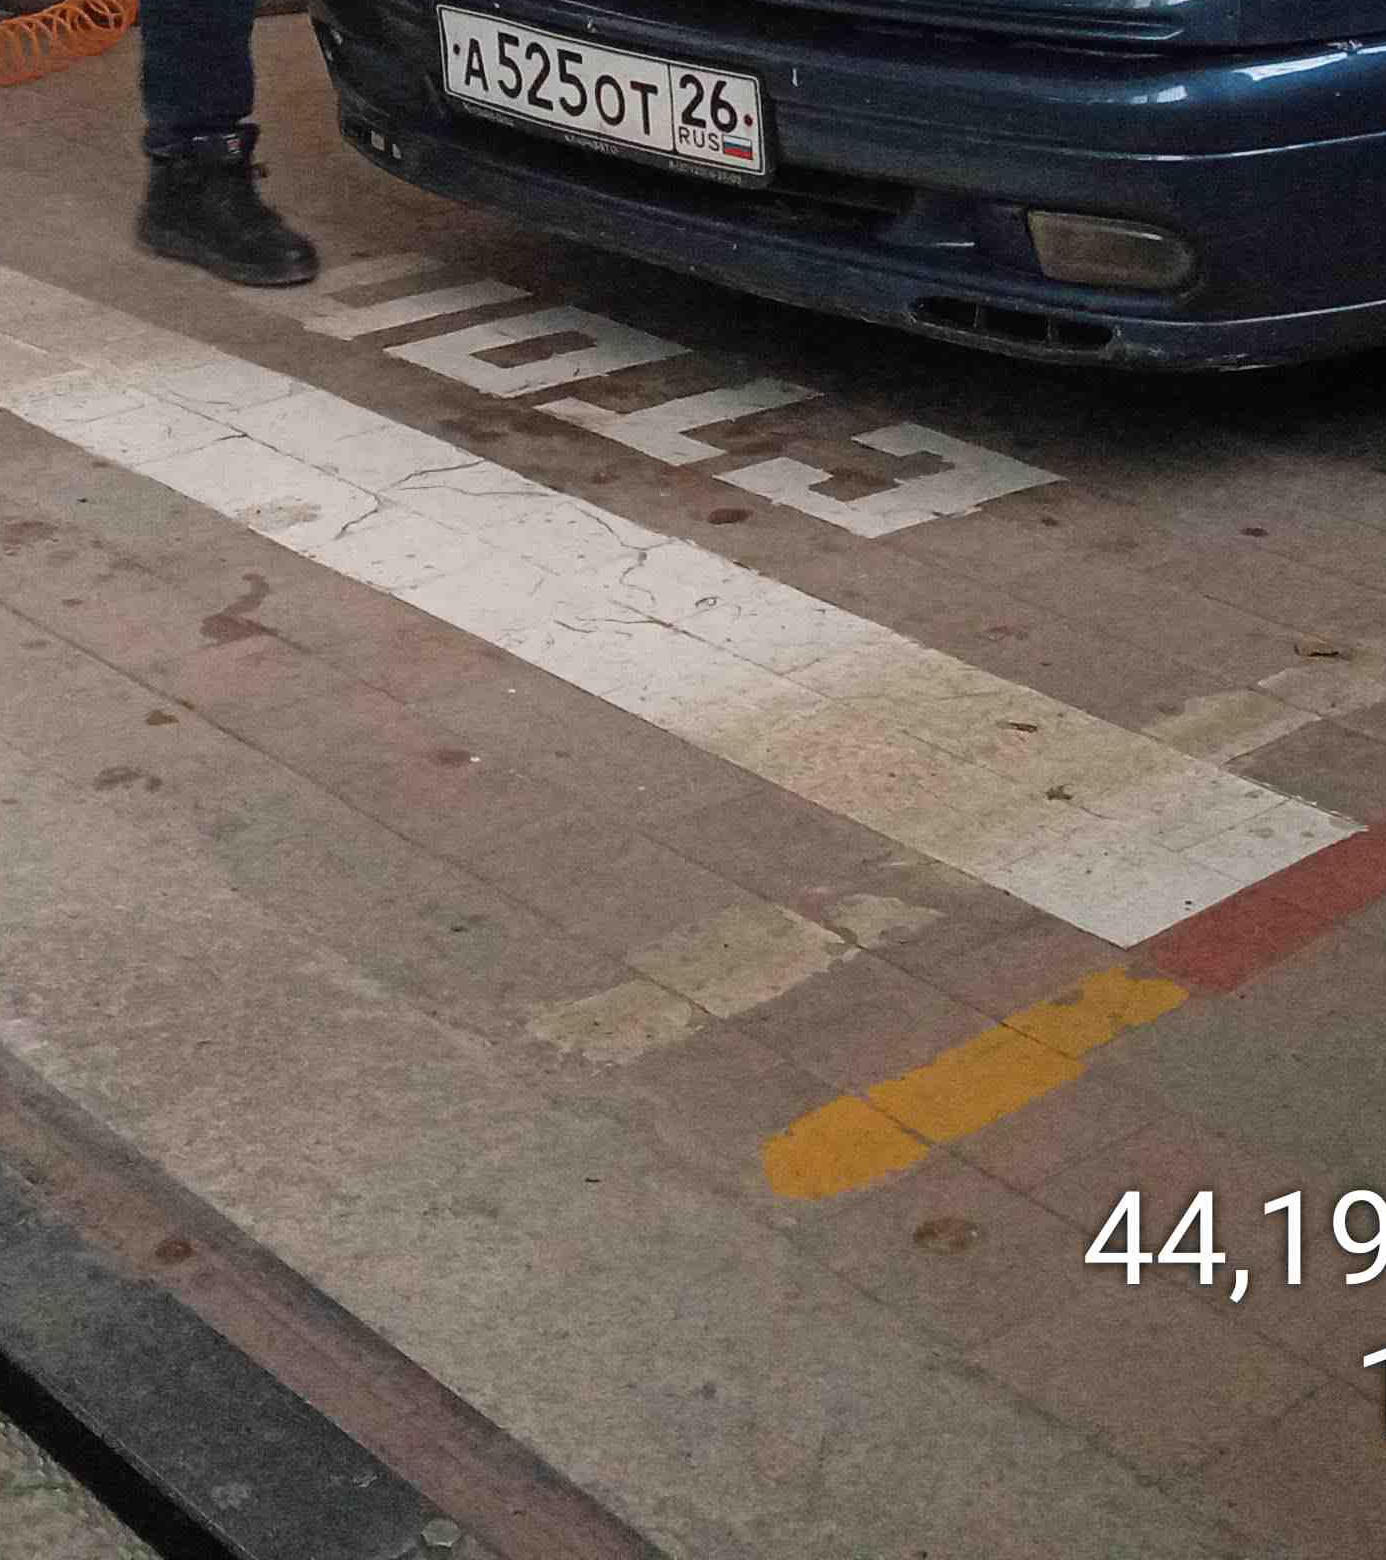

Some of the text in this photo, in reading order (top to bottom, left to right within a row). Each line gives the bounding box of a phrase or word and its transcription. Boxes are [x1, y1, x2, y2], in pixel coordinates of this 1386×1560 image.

[463, 31, 738, 136] А525ОТ 26
[678, 126, 722, 153] RUS
